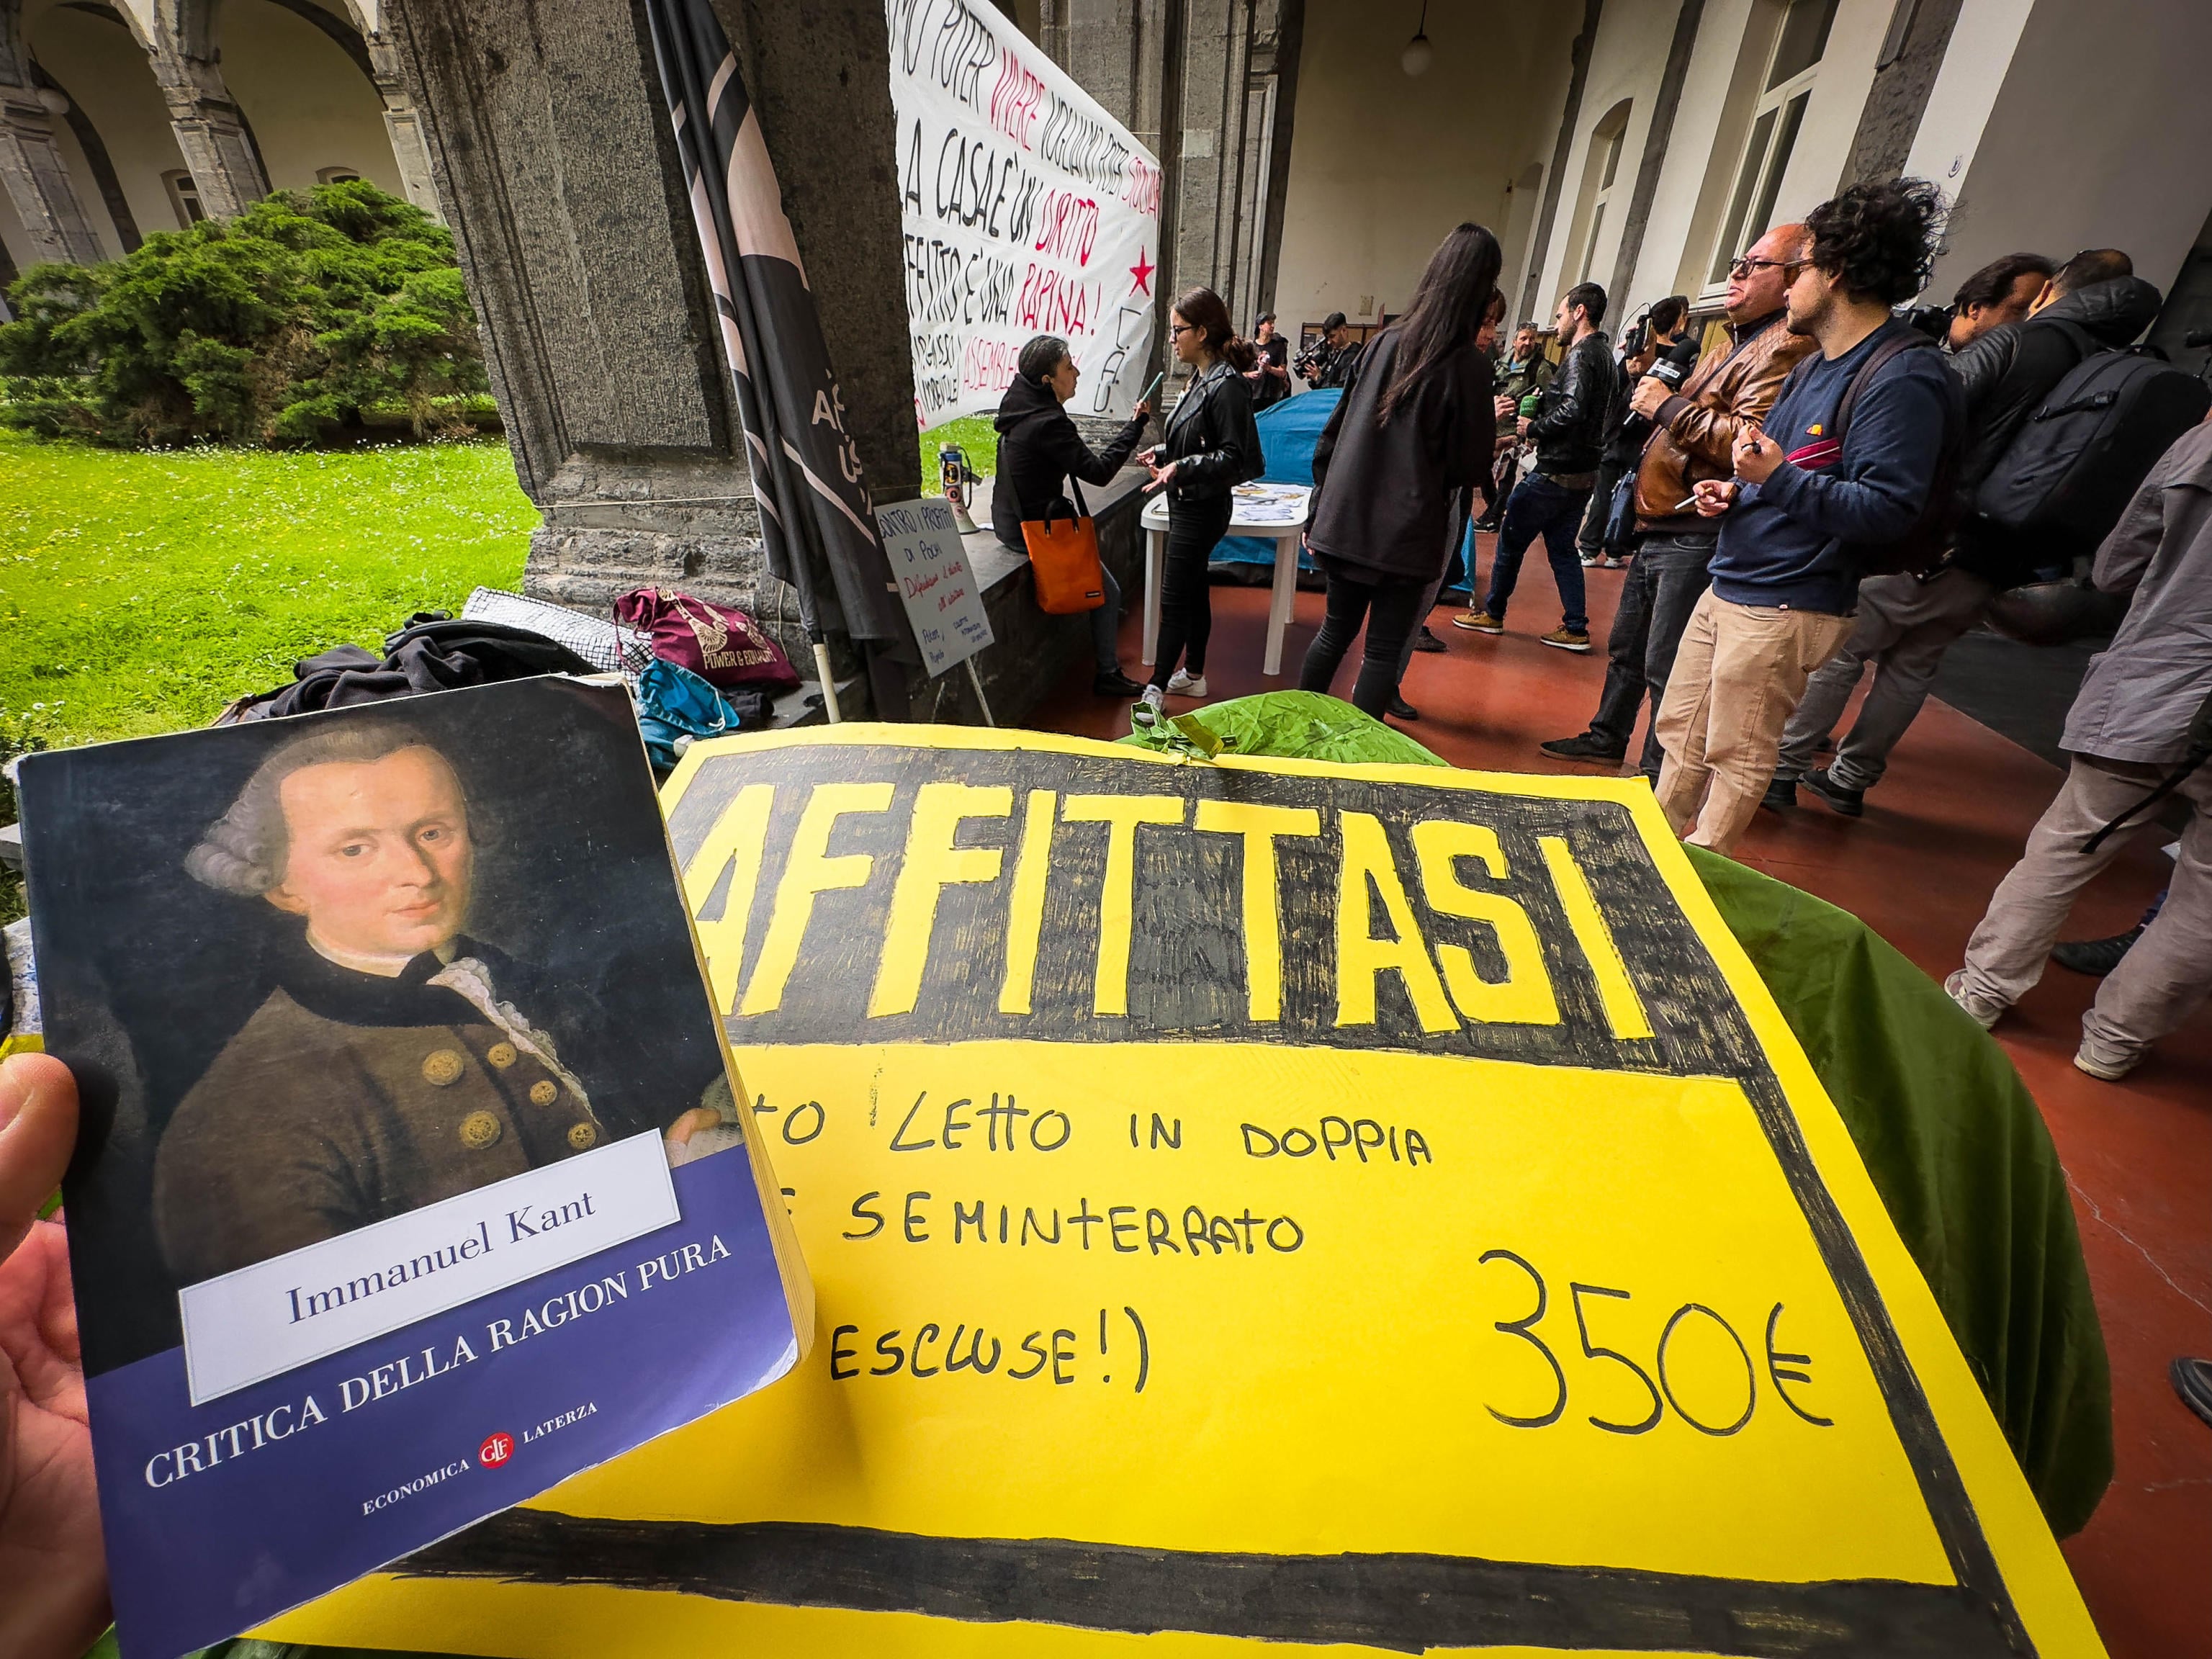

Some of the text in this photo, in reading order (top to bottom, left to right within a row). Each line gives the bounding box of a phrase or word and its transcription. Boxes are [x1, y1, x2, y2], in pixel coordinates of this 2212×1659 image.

[930, 0, 996, 115] POTER
[992, 46, 1046, 152] VIVERE
[937, 128, 995, 232] CASA
[1014, 263, 1101, 336] RAPINA!
[963, 336, 1020, 395] ASSEMBLE
[703, 648, 778, 670] POWER & EQUALITY
[683, 782, 1655, 1040] AFFITTASI
[1130, 1112, 1182, 1149] IN
[1240, 1115, 1433, 1166] DOPPIA
[285, 1192, 597, 1325] Immanuel Kant
[144, 1233, 732, 1489] CRITICA DELLA RAGION PURA
[1478, 1249, 1835, 1437] 350€
[362, 1458, 470, 1516] ECONOMICA
[522, 1401, 599, 1444] LATERZA
